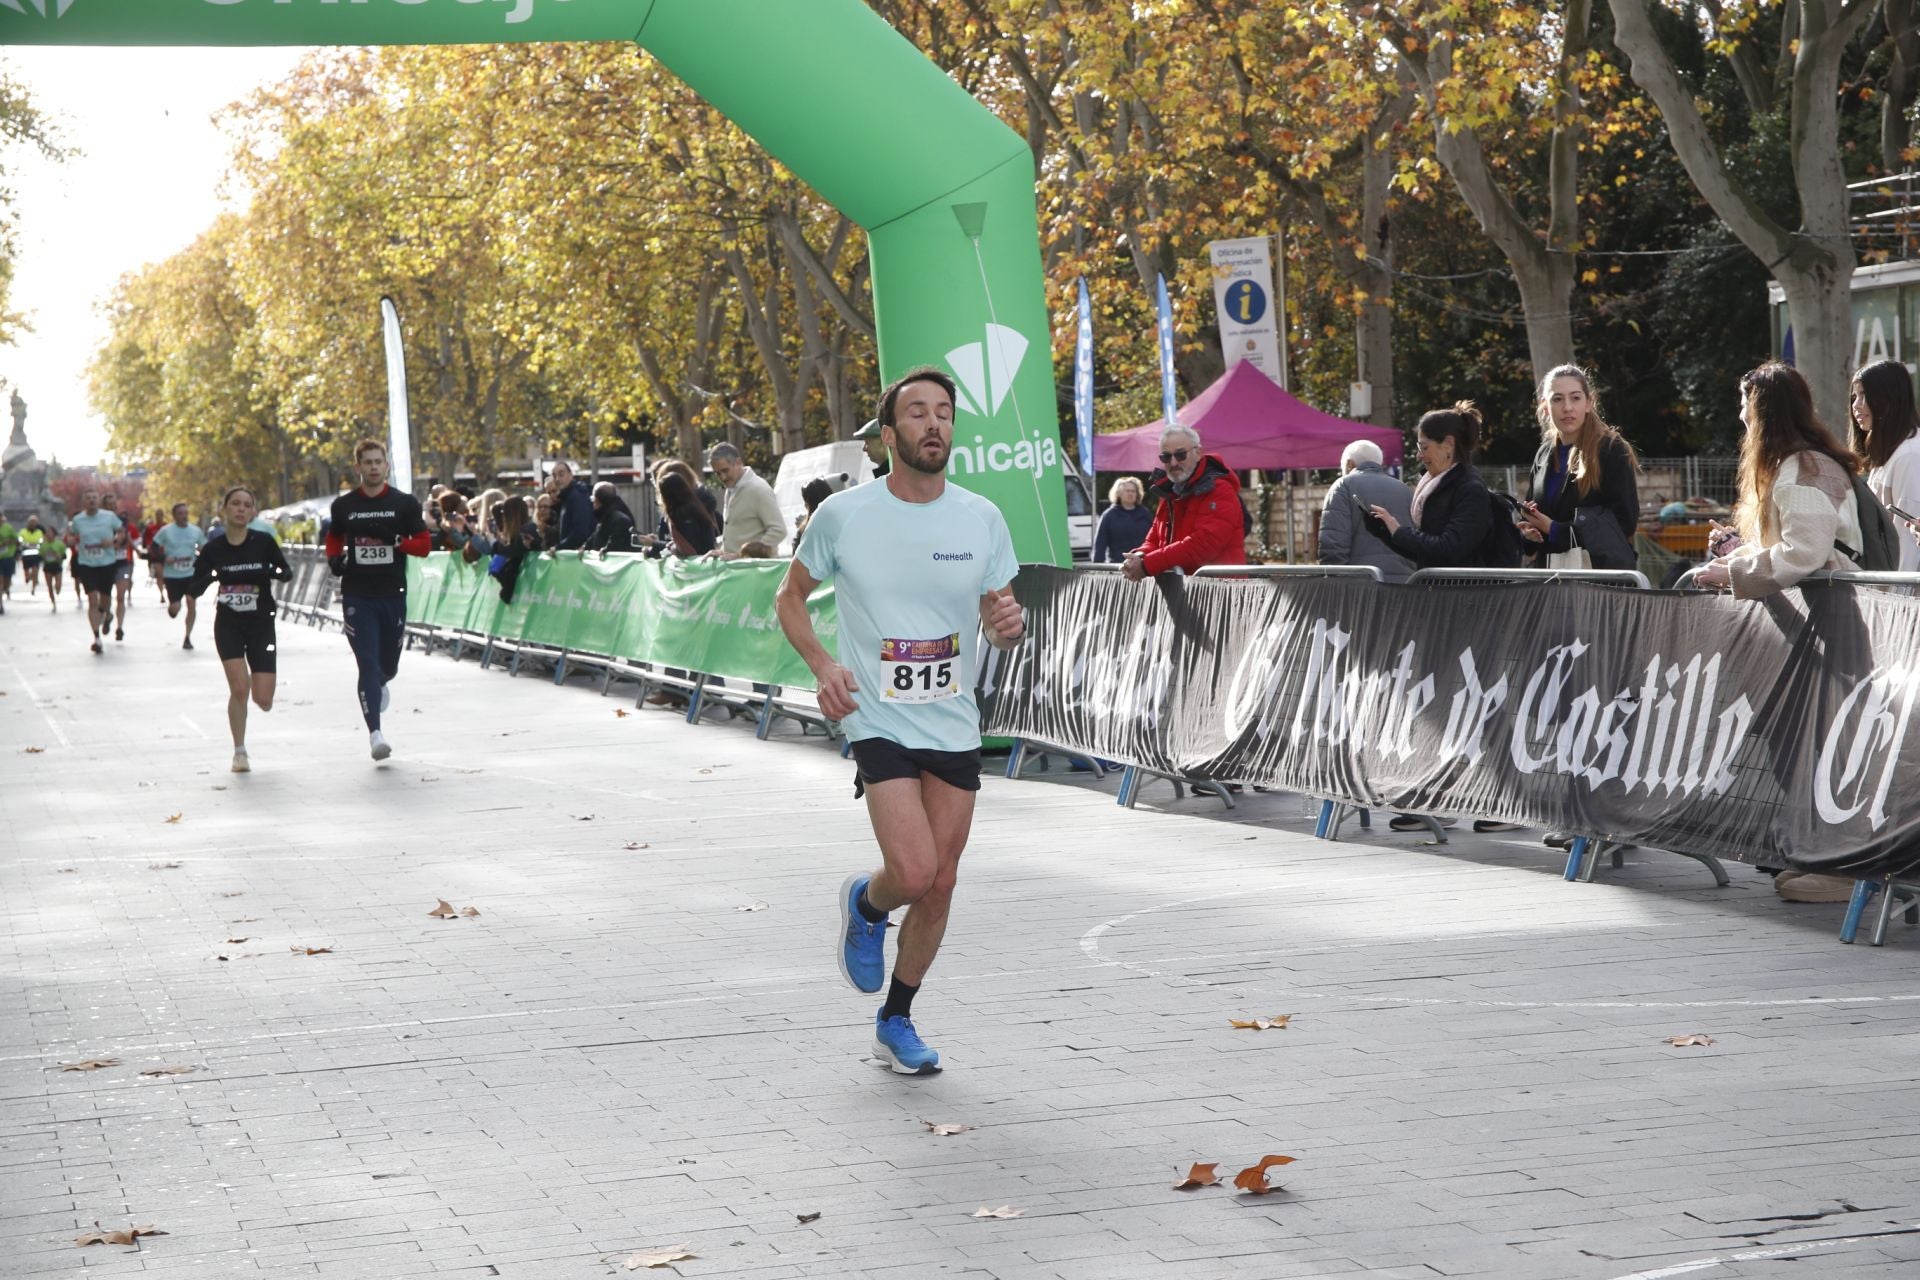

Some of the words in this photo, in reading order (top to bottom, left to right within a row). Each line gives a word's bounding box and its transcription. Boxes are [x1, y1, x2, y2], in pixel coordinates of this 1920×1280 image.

[1217, 247, 1241, 258] Oficina
[947, 429, 1057, 479] nicaja
[357, 510, 396, 519] DECATHLON
[360, 547, 387, 559] 238
[933, 551, 973, 561] OneHealth
[225, 595, 252, 606] 239
[893, 662, 952, 691] 815
[1437, 646, 1508, 769] de
[1510, 637, 1754, 800] Castilla
